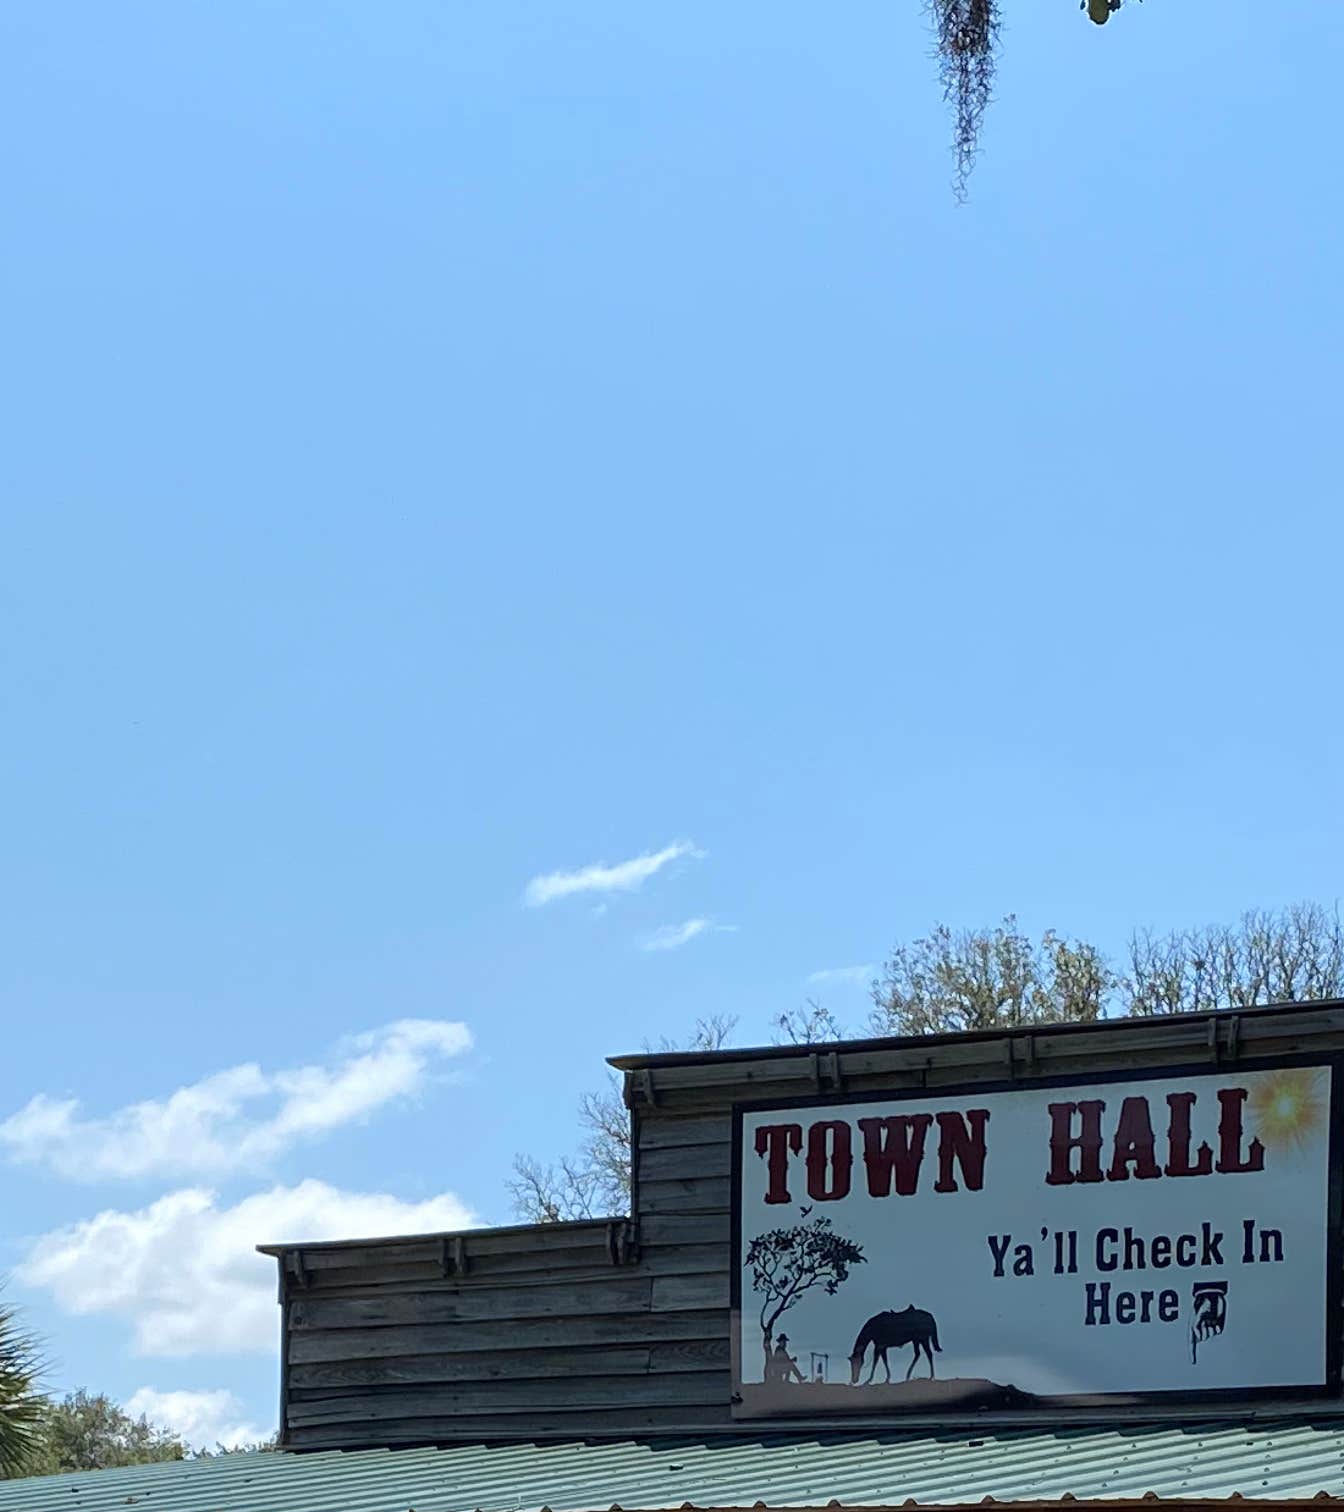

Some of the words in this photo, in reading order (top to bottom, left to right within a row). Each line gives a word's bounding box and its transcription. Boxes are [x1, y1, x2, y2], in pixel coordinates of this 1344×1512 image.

[755, 1109, 990, 1205] TOWN
[1045, 1087, 1266, 1187] HALL
[988, 1227, 1078, 1278] Ya'll
[1095, 1222, 1224, 1272] Check
[1242, 1219, 1285, 1264] In
[1084, 1281, 1179, 1327] Here
